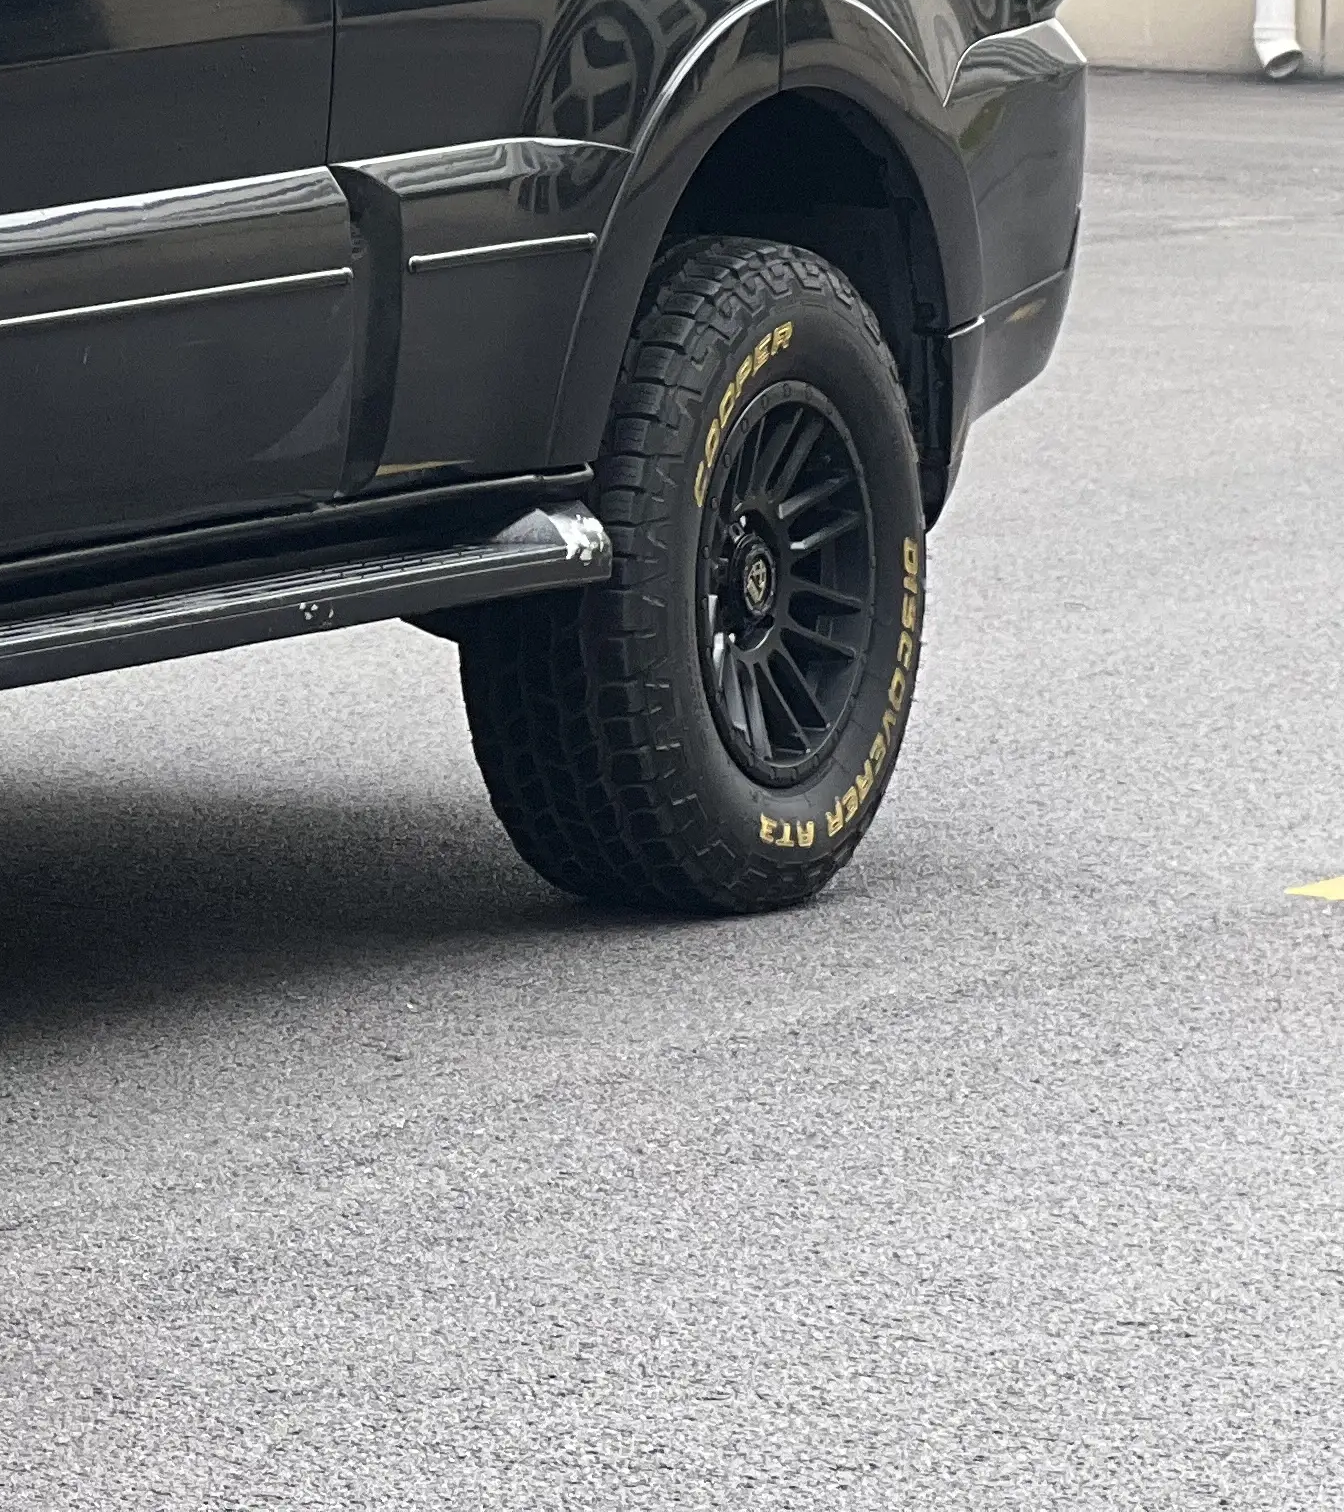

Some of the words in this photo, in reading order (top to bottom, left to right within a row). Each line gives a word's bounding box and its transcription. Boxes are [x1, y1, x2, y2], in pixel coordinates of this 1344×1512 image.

[695, 320, 794, 507] COOPER
[827, 536, 918, 839] DISCOVERER
[760, 812, 814, 848] AT3
